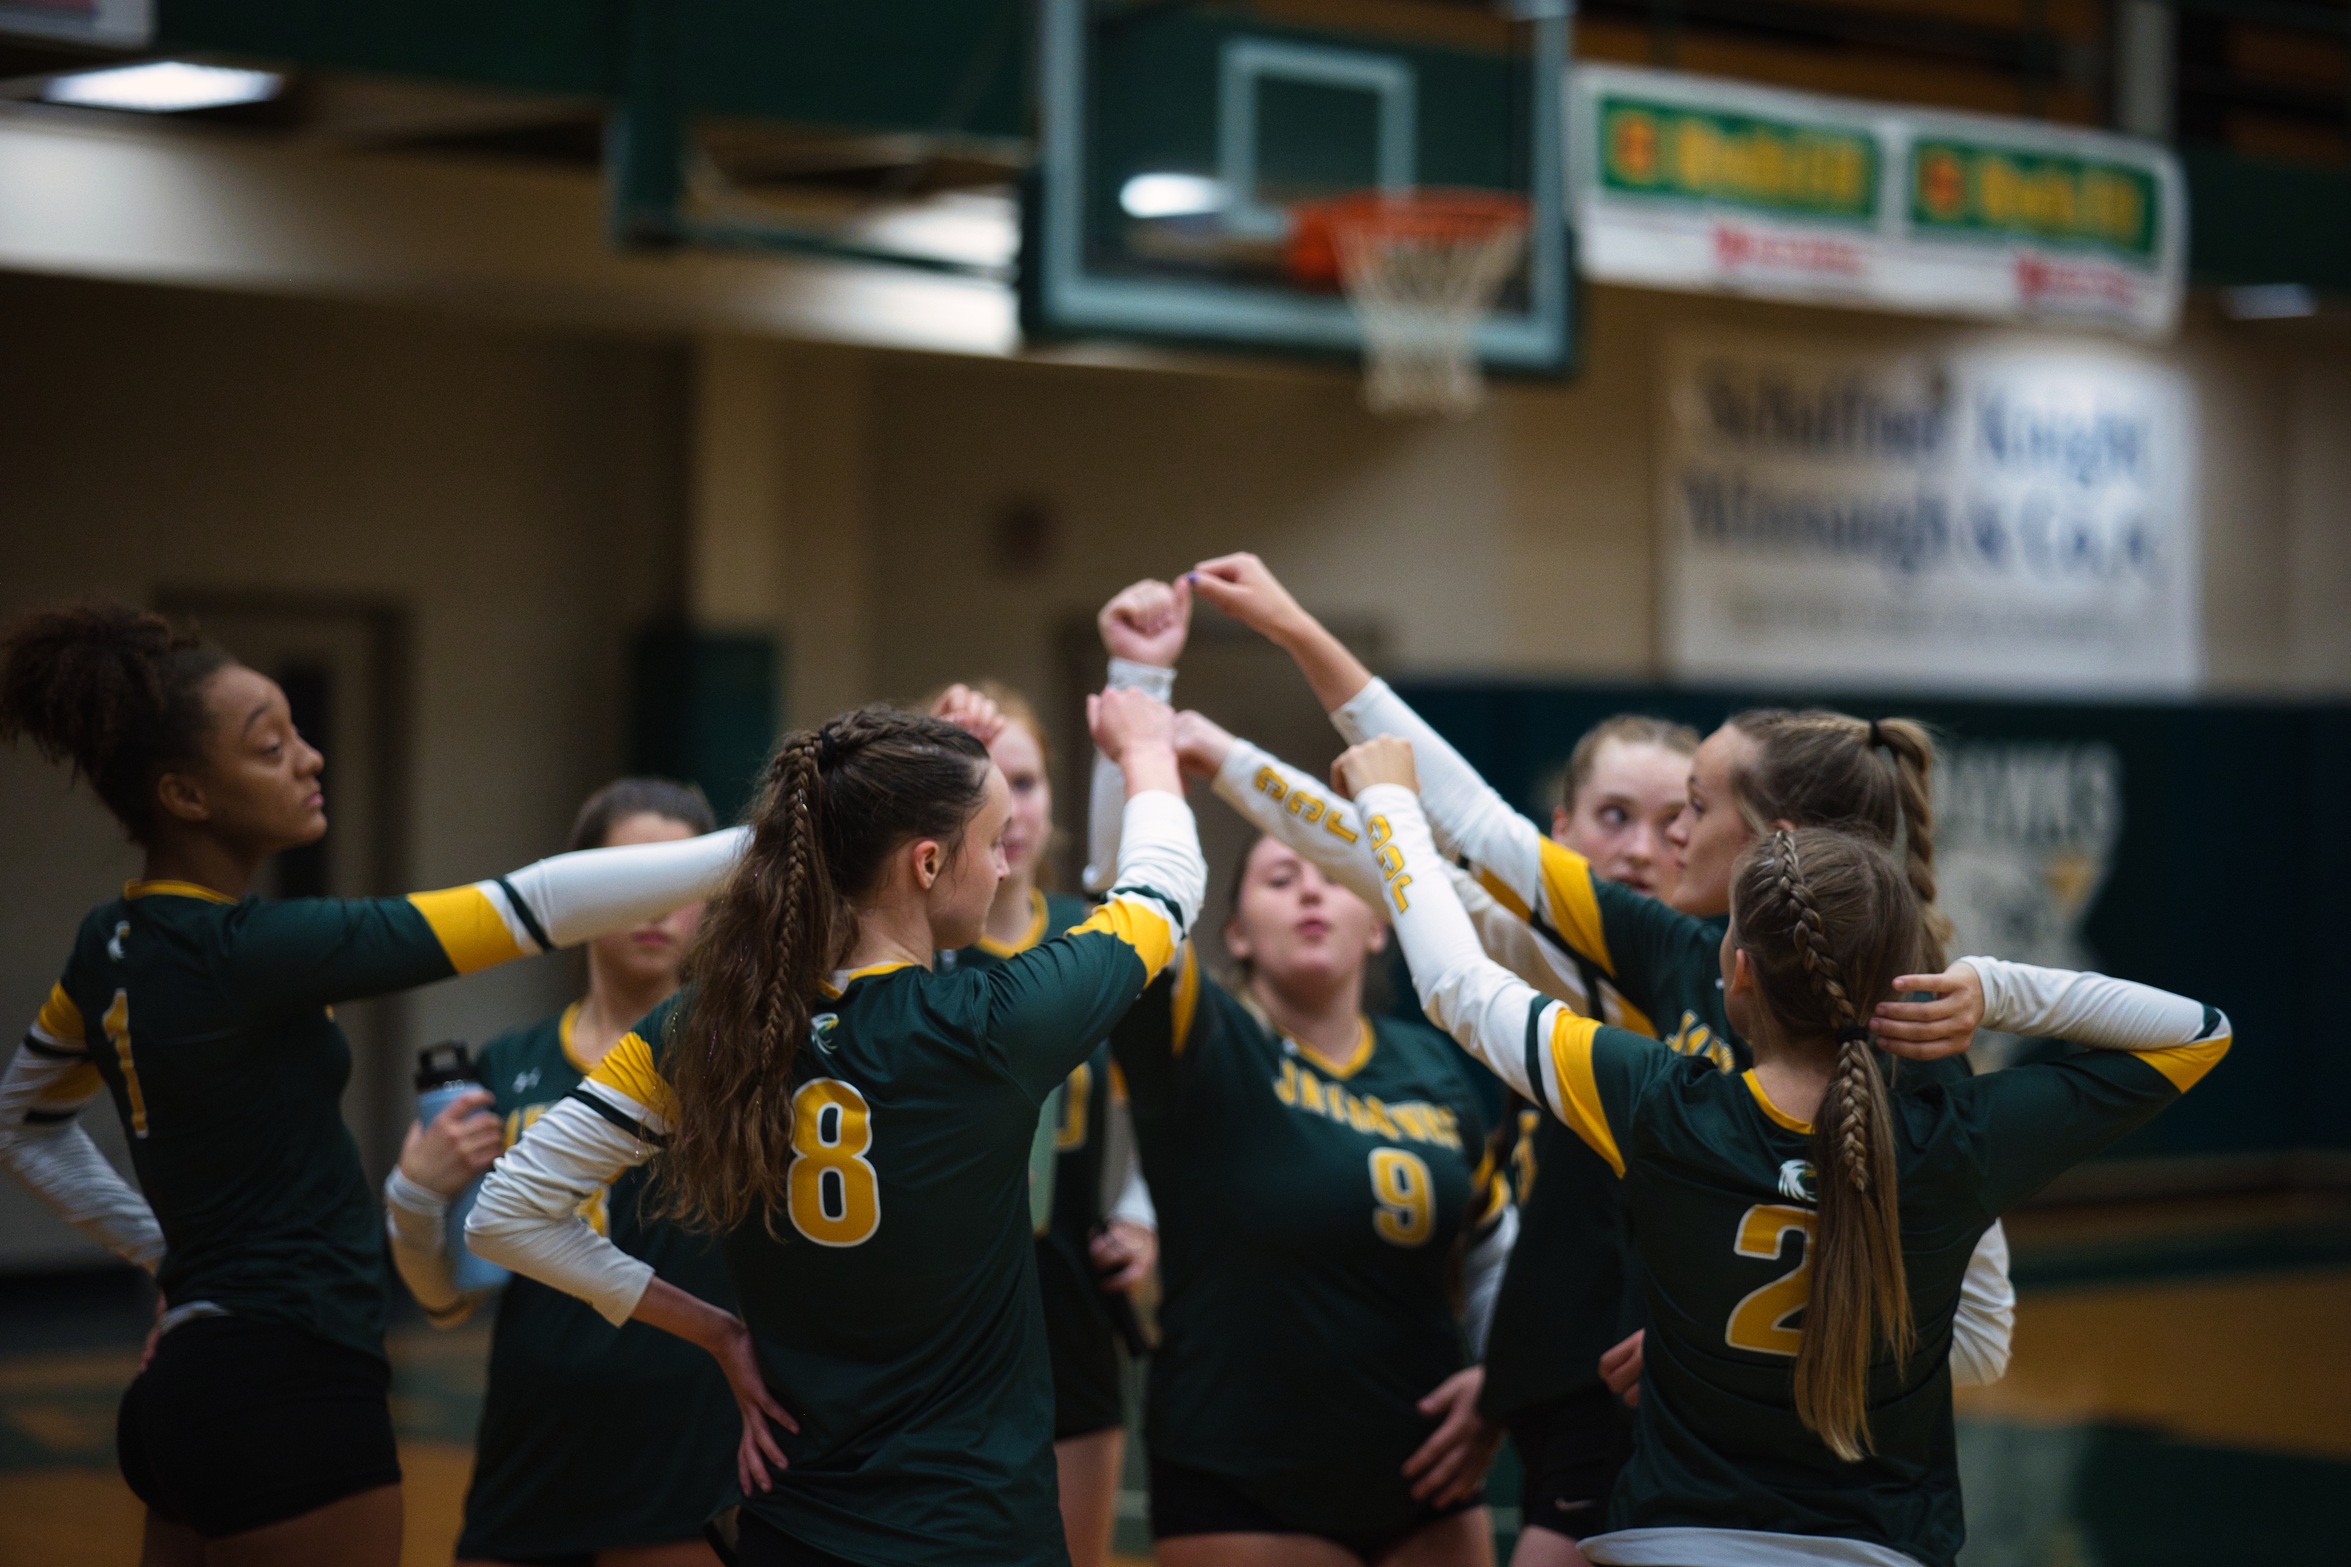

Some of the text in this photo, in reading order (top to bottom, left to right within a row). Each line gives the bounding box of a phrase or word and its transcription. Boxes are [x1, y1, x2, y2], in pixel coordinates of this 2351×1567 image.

[102, 987, 149, 1139] 1
[787, 1077, 881, 1247] 8
[1368, 1146, 1436, 1247] 9
[1725, 1203, 1820, 1357] 2
